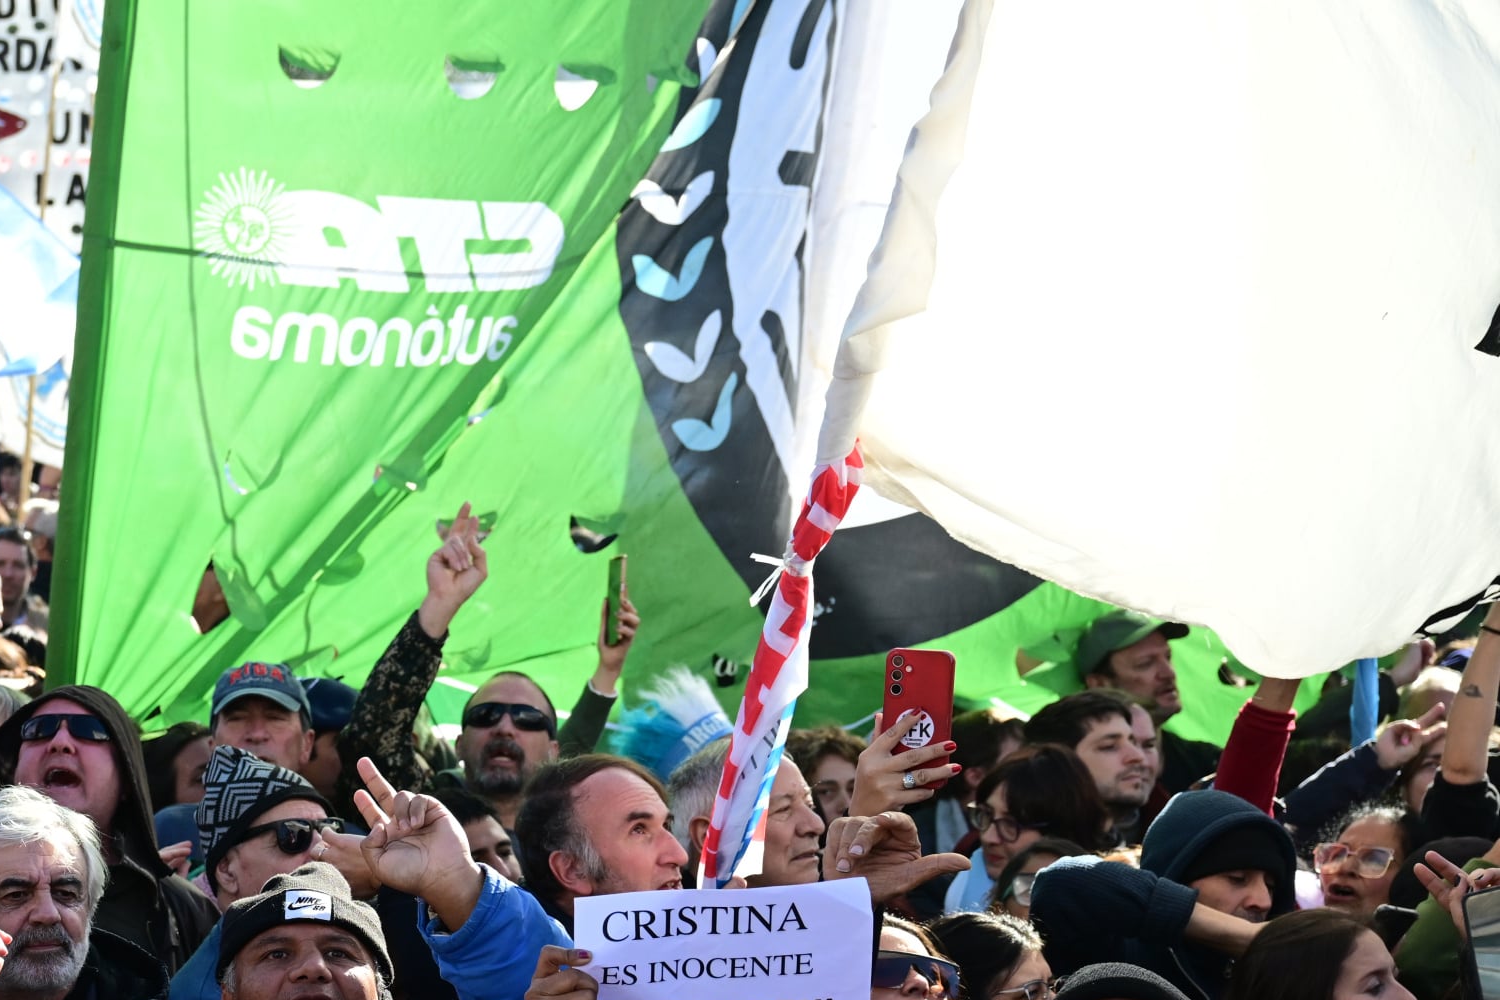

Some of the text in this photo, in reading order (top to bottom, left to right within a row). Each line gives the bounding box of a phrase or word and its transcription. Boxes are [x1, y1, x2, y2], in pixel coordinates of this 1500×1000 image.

[601, 902, 809, 942] CRISTINA
[600, 952, 815, 987] ES INOCENTE
